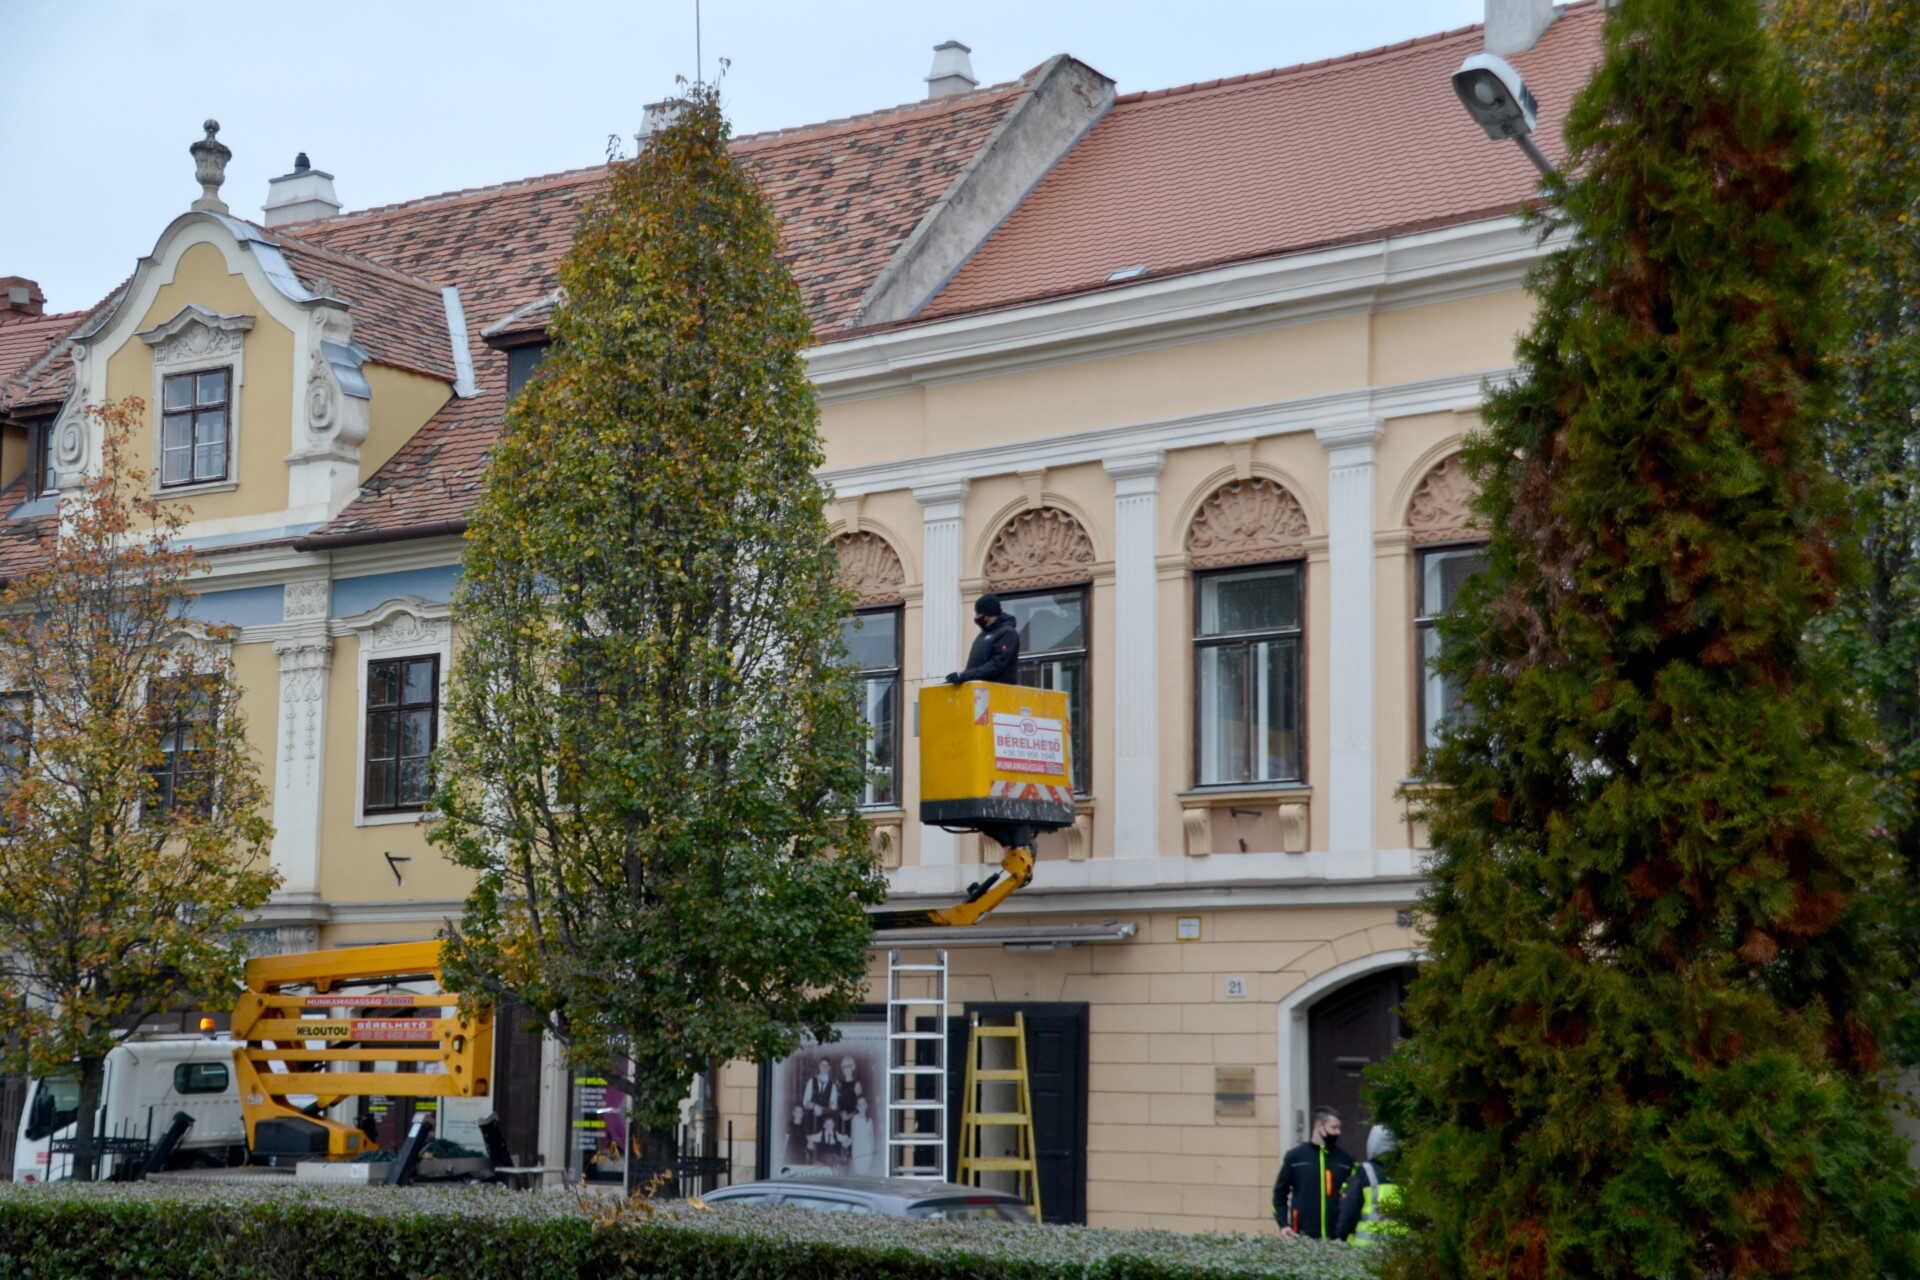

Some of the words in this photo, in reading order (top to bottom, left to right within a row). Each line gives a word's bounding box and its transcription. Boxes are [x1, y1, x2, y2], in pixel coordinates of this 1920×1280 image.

[996, 733, 1061, 752] BÉRELHETŐ
[1228, 980, 1242, 994] 21
[356, 1019, 428, 1029] BÉRELHETŐ
